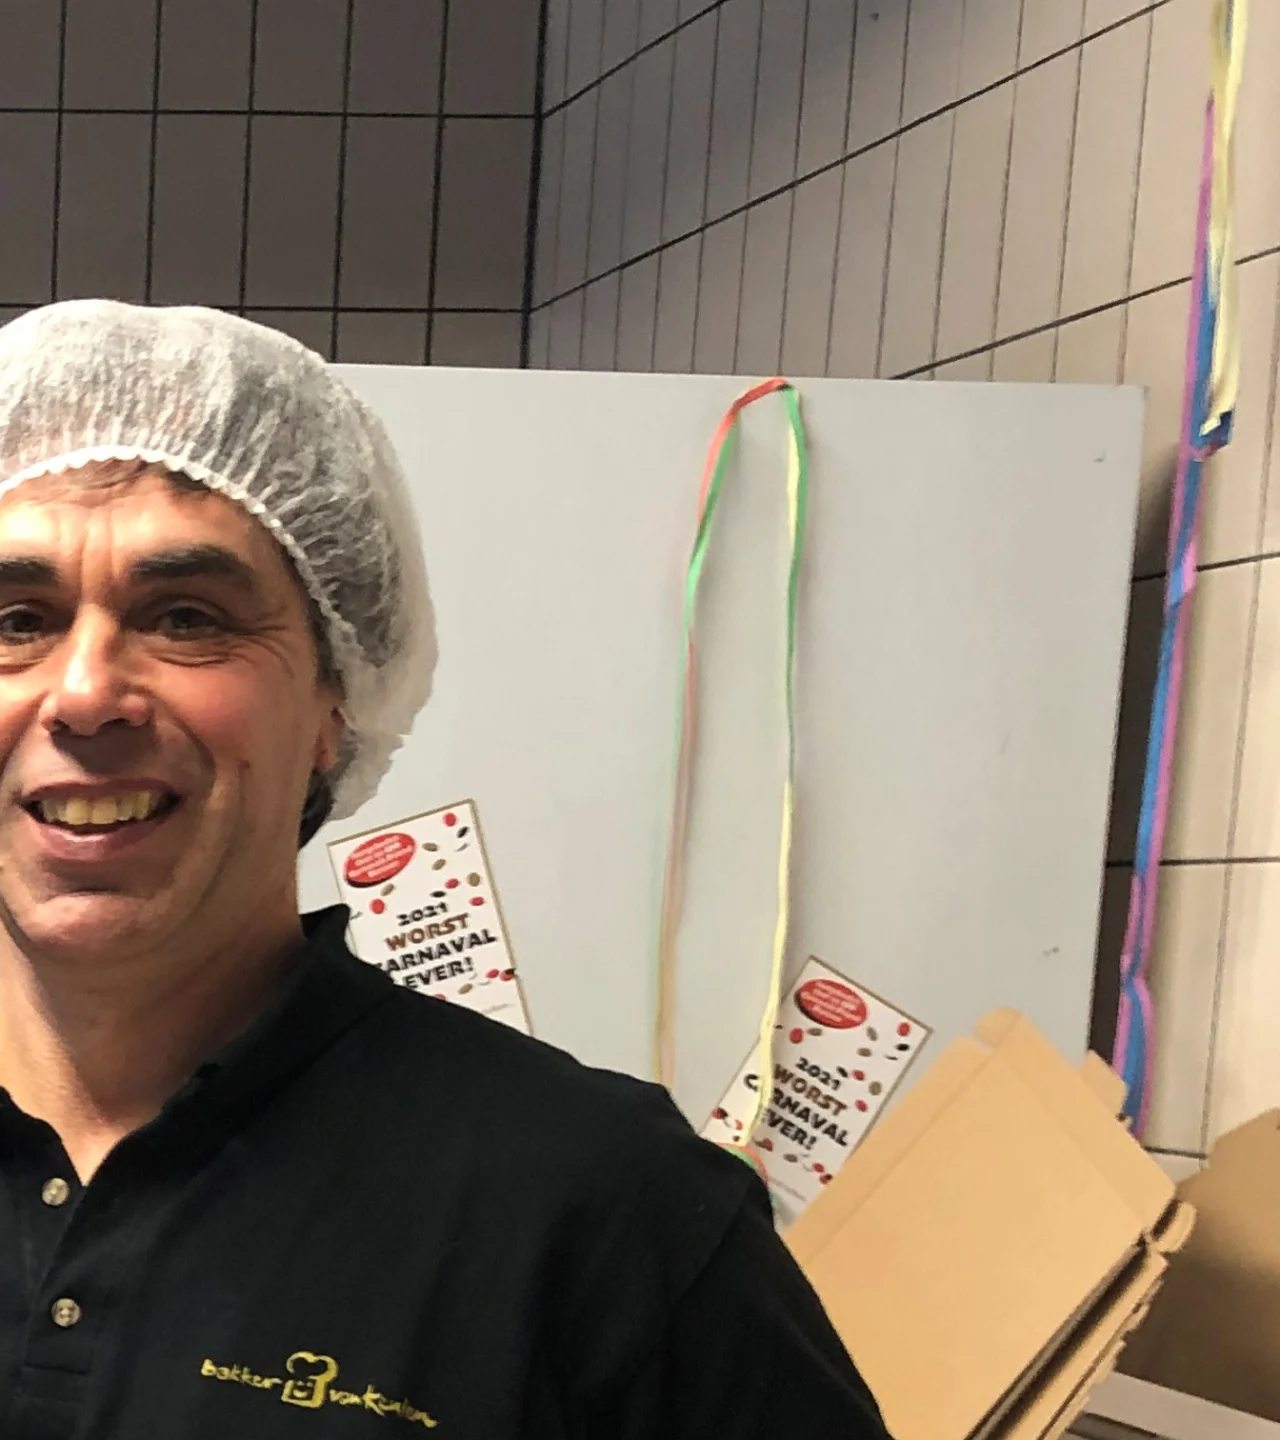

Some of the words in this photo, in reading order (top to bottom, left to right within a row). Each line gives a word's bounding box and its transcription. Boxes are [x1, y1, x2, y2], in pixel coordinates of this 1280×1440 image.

[385, 913, 469, 951] WORST
[397, 902, 448, 926] 2021
[376, 929, 497, 973] ARNAVAL
[403, 957, 473, 989] EVER!
[774, 1063, 848, 1116] WORST
[795, 1057, 841, 1091] 2021
[744, 1074, 848, 1147] CRNAVAL
[764, 1108, 817, 1150] VER!
[200, 1359, 282, 1389] bakker
